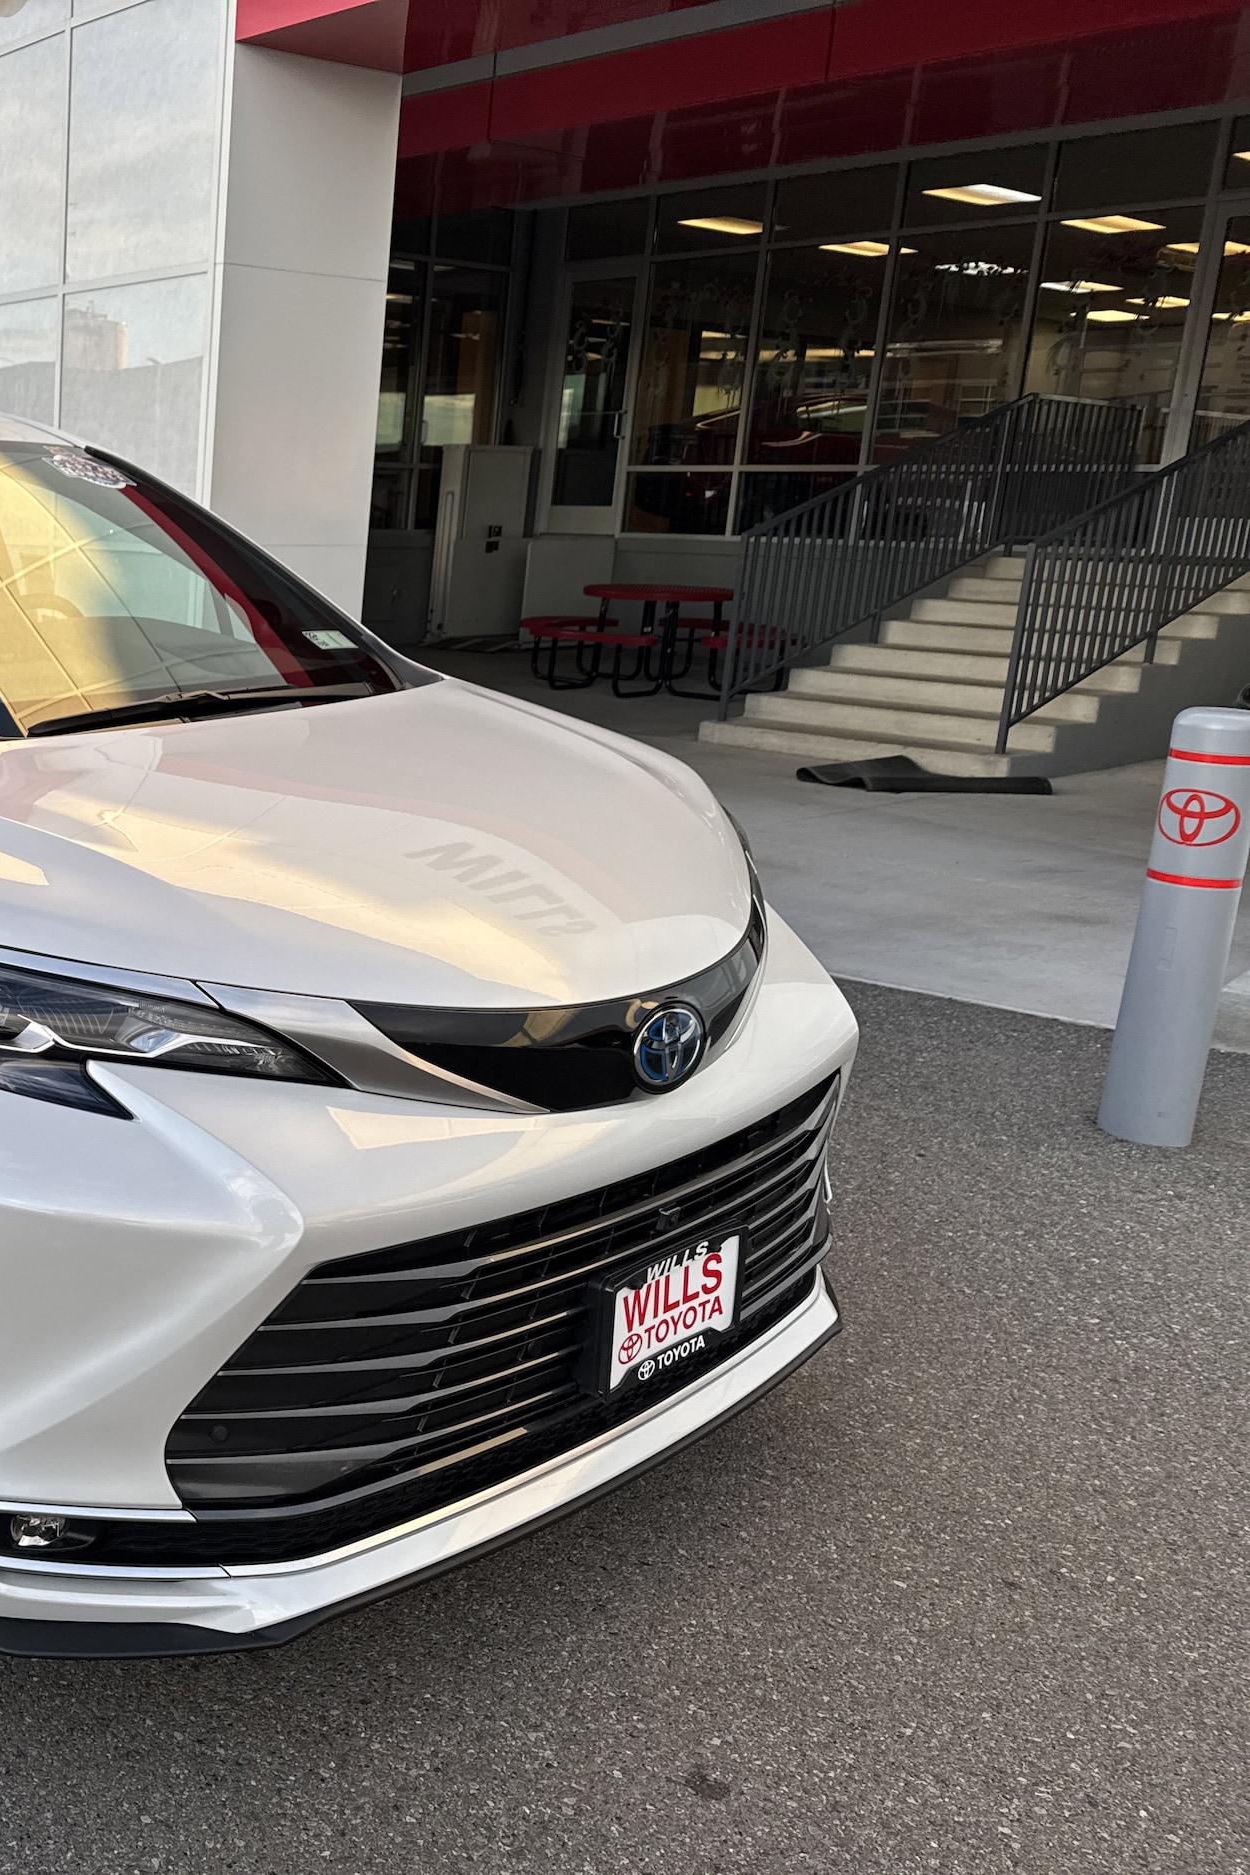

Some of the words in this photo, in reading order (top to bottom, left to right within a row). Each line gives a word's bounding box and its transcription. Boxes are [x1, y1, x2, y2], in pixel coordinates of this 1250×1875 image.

[646, 1240, 710, 1283] WILLS
[622, 1252, 723, 1333] WILLS
[644, 1295, 723, 1349] TOYOTA
[657, 1335, 706, 1369] TOYOTA
